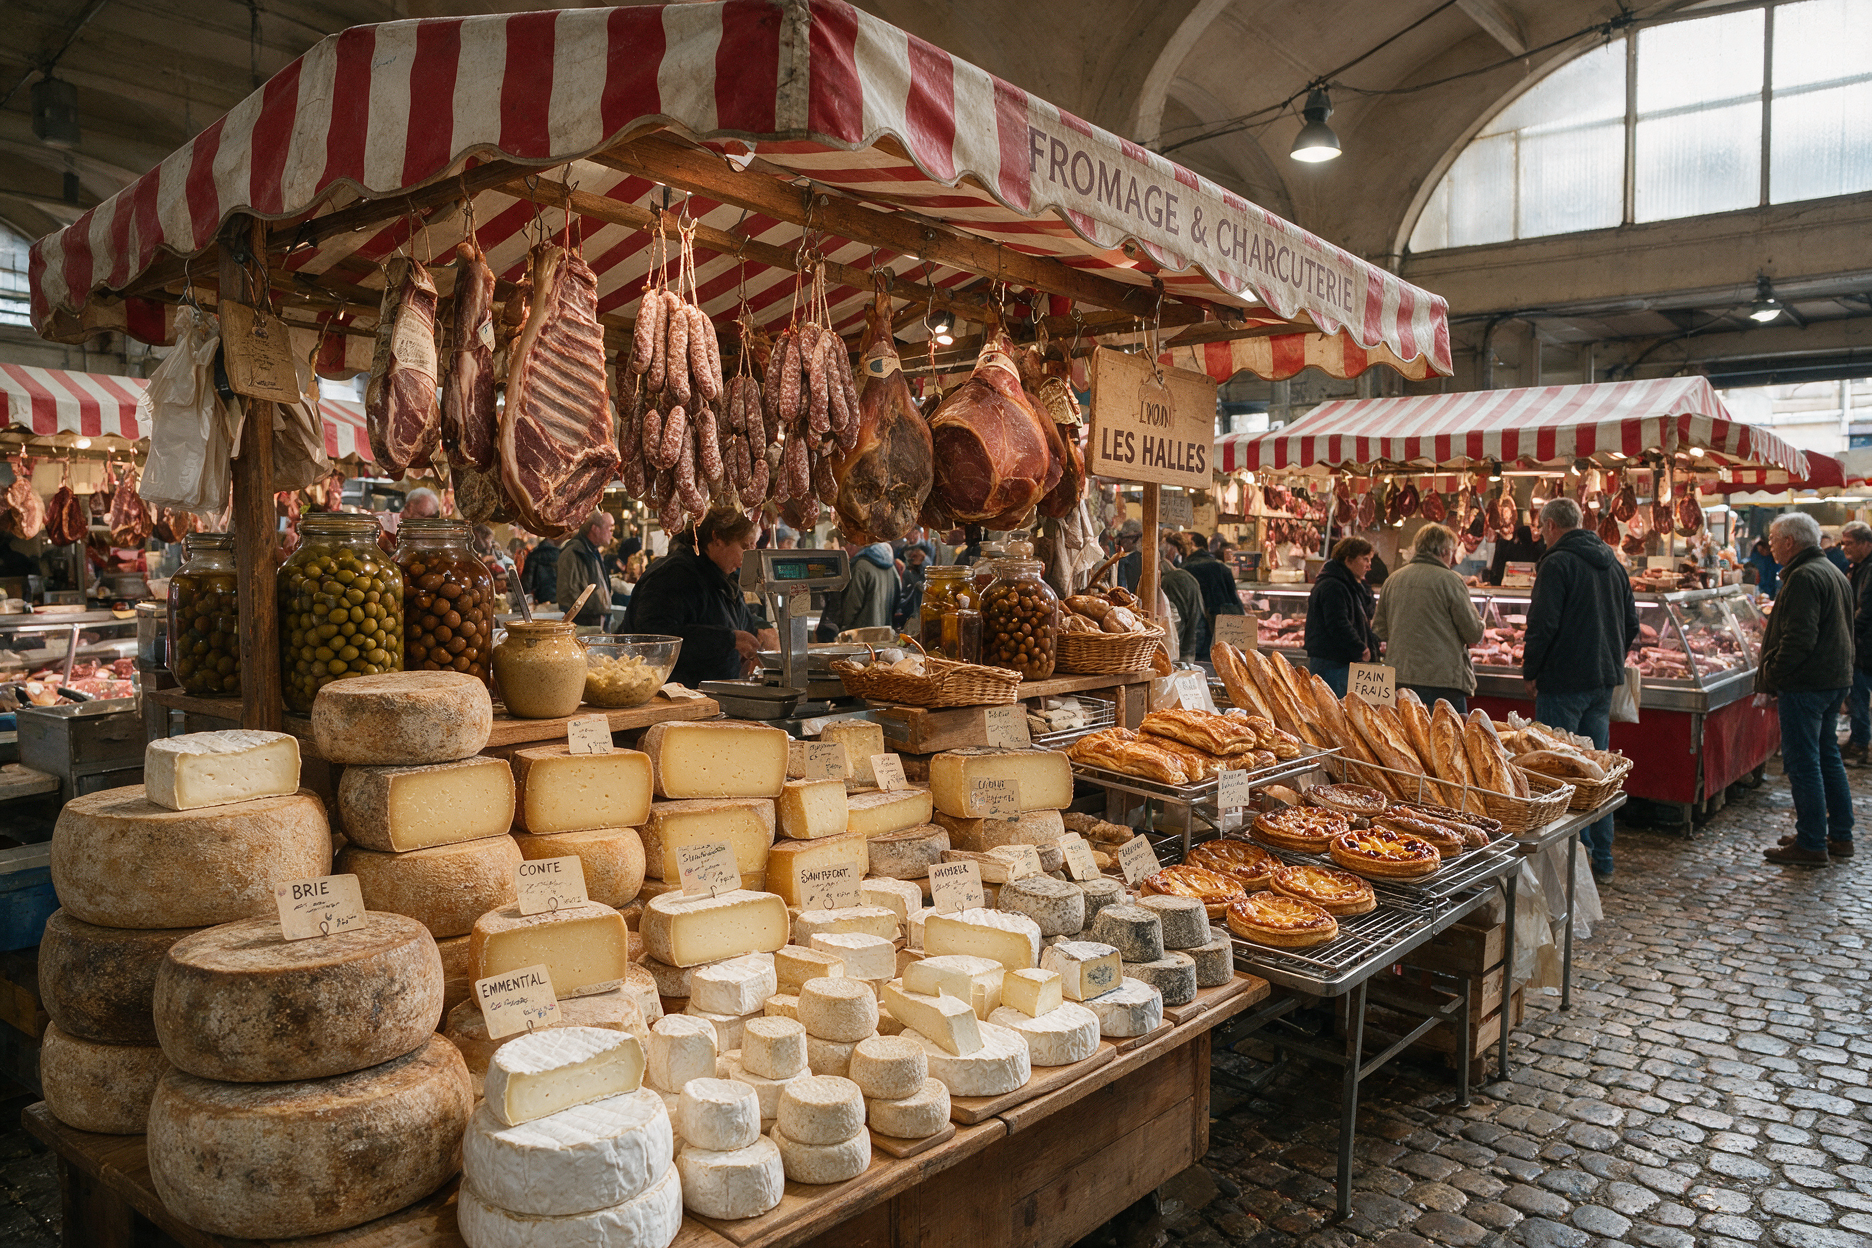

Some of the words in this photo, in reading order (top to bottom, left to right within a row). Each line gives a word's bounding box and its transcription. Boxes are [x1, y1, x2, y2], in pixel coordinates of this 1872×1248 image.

[1028, 125, 1180, 237] FROMAGE
[1190, 205, 1209, 248] &
[1216, 217, 1354, 314] CHARCUTERIE
[1101, 426, 1136, 464] LES
[1141, 434, 1206, 475] HALLES
[1356, 669, 1385, 683] PAIN
[1354, 682, 1391, 699] FRAIS
[519, 861, 562, 877] CONTE
[292, 881, 330, 900] BRIE
